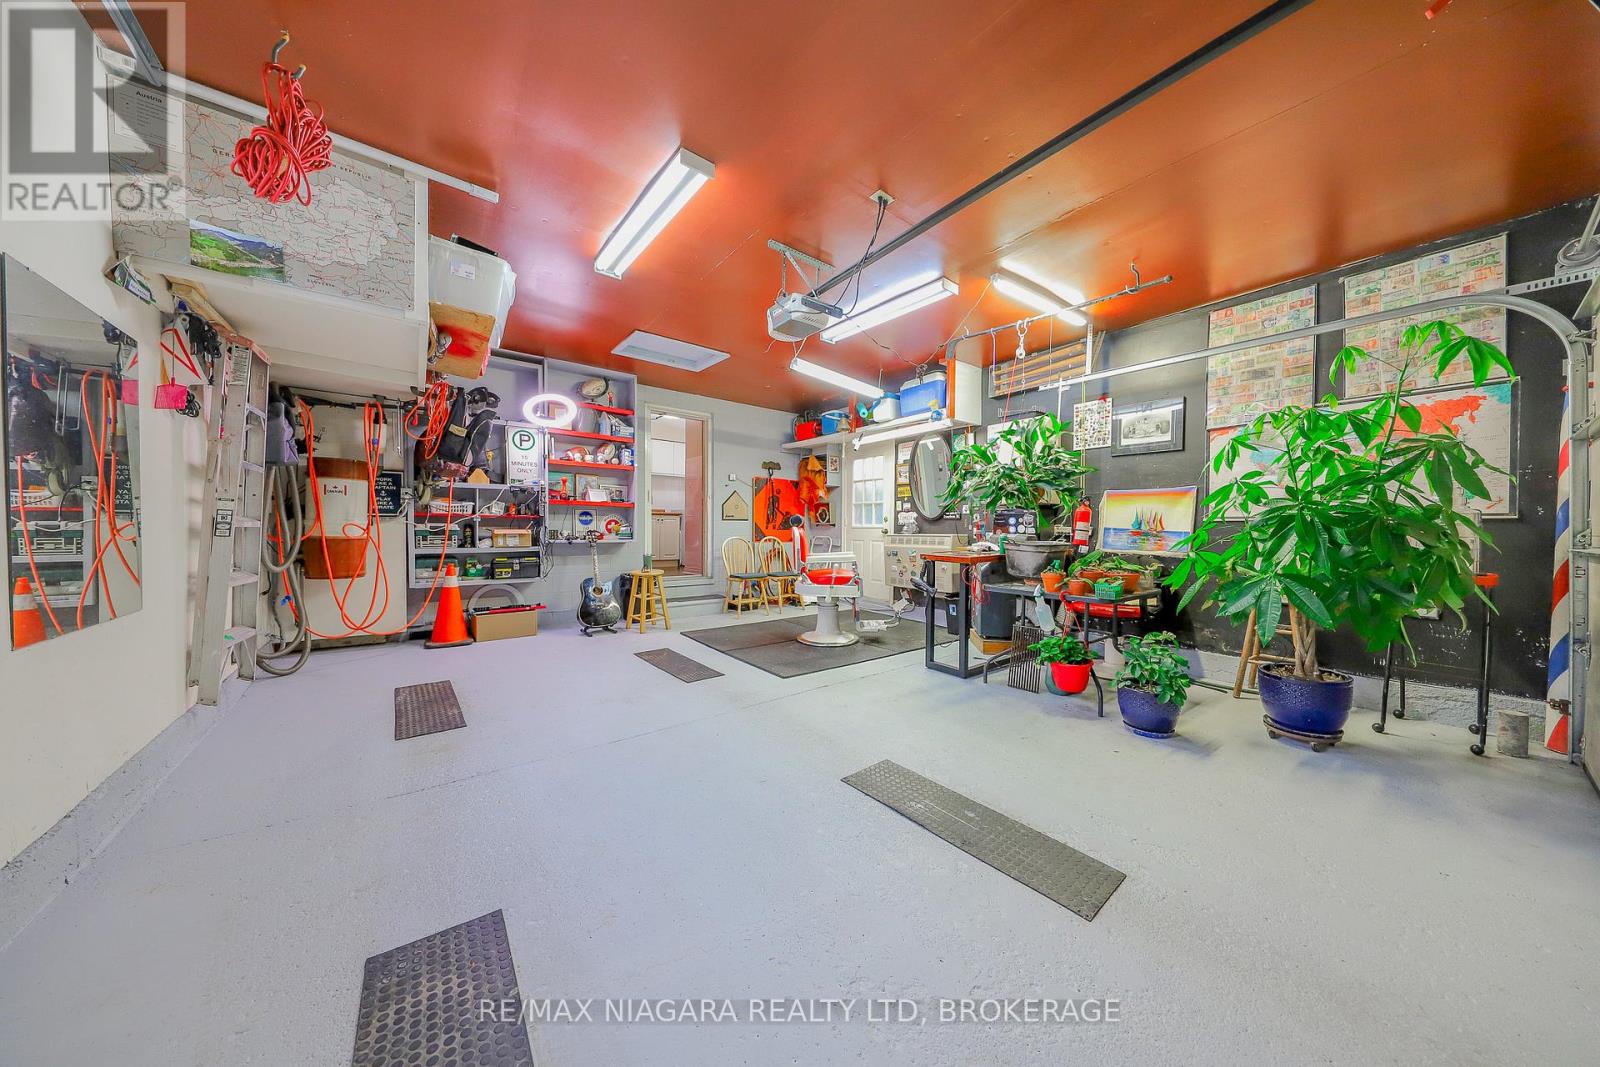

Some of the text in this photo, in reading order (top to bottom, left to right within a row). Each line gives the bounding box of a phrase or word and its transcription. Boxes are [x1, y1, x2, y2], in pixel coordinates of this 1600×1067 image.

[136, 90, 163, 104] Austria
[519, 433, 531, 447] P
[511, 460, 538, 468] MINUTES
